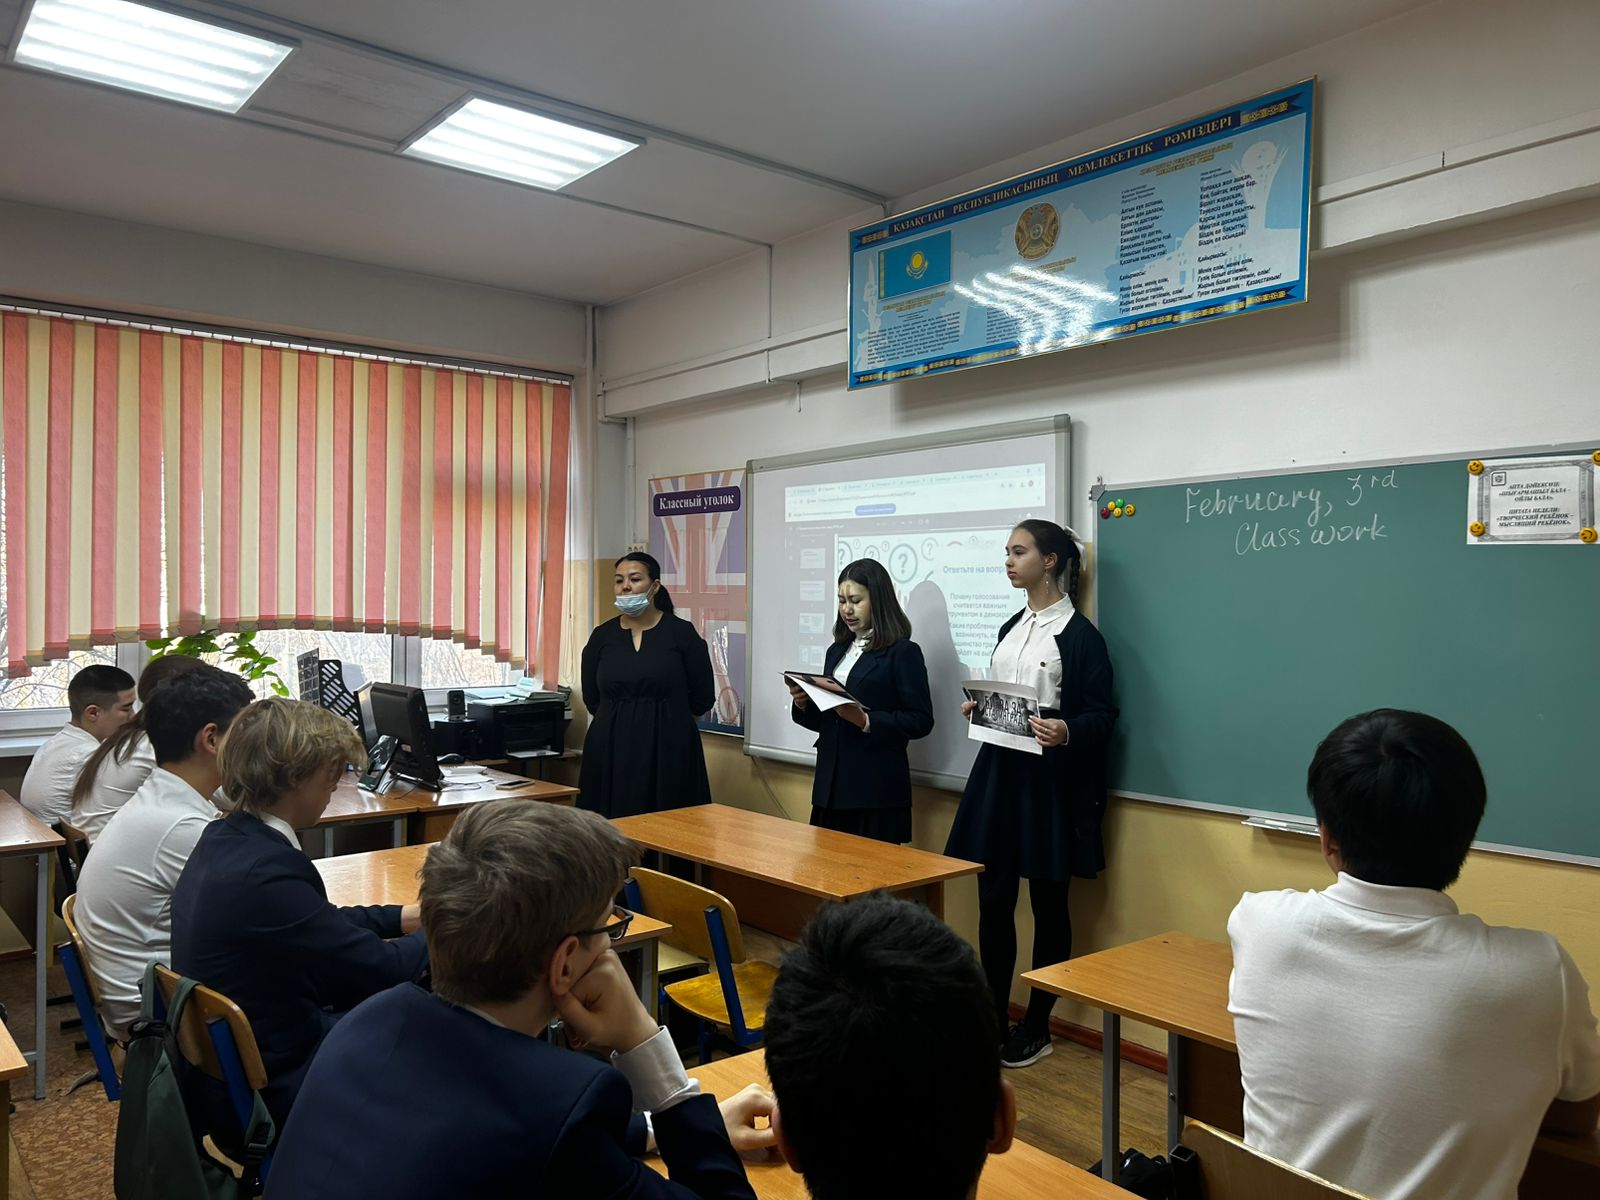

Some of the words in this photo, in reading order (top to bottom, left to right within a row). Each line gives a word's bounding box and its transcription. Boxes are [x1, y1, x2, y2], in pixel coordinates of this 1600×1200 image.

[893, 210, 944, 233] ҚАЗАҚСТАН
[953, 172, 1059, 214] РЕСПУБЛИКАСЫНЫҢ
[1067, 141, 1153, 178] МЕМЛЕКЕТТІК
[1164, 115, 1233, 147] РӘМІЗДЕРІ
[660, 495, 701, 510] Классный
[704, 494, 734, 510] уголок
[1185, 487, 1333, 527] February,
[1235, 521, 1300, 555] Class
[1310, 513, 1389, 546] work
